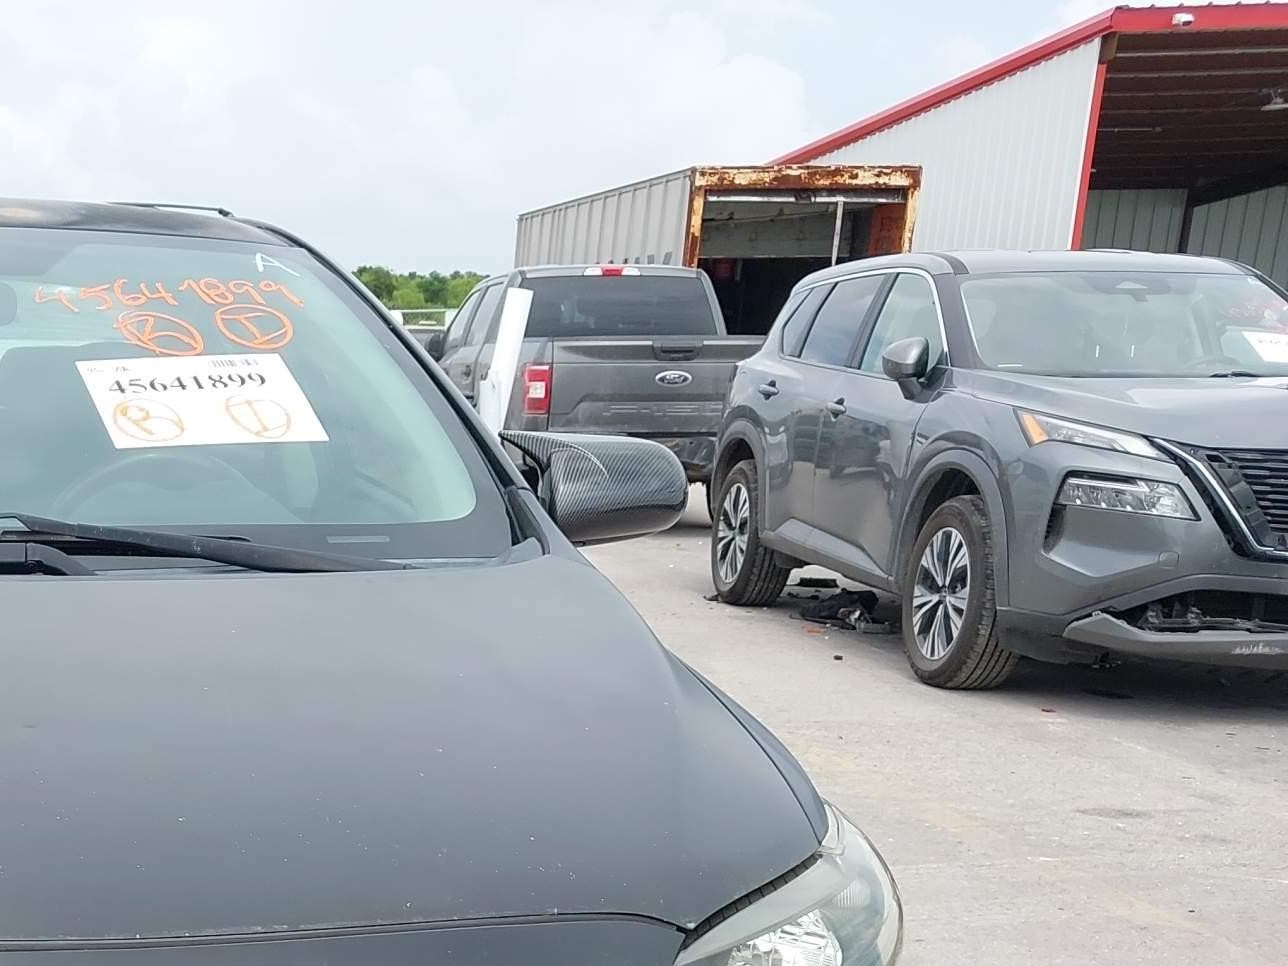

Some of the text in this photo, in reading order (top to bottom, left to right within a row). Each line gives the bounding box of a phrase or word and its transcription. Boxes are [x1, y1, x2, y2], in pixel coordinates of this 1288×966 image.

[253, 252, 300, 277] A
[34, 277, 304, 313] 45641899
[108, 372, 267, 394] 45641899
